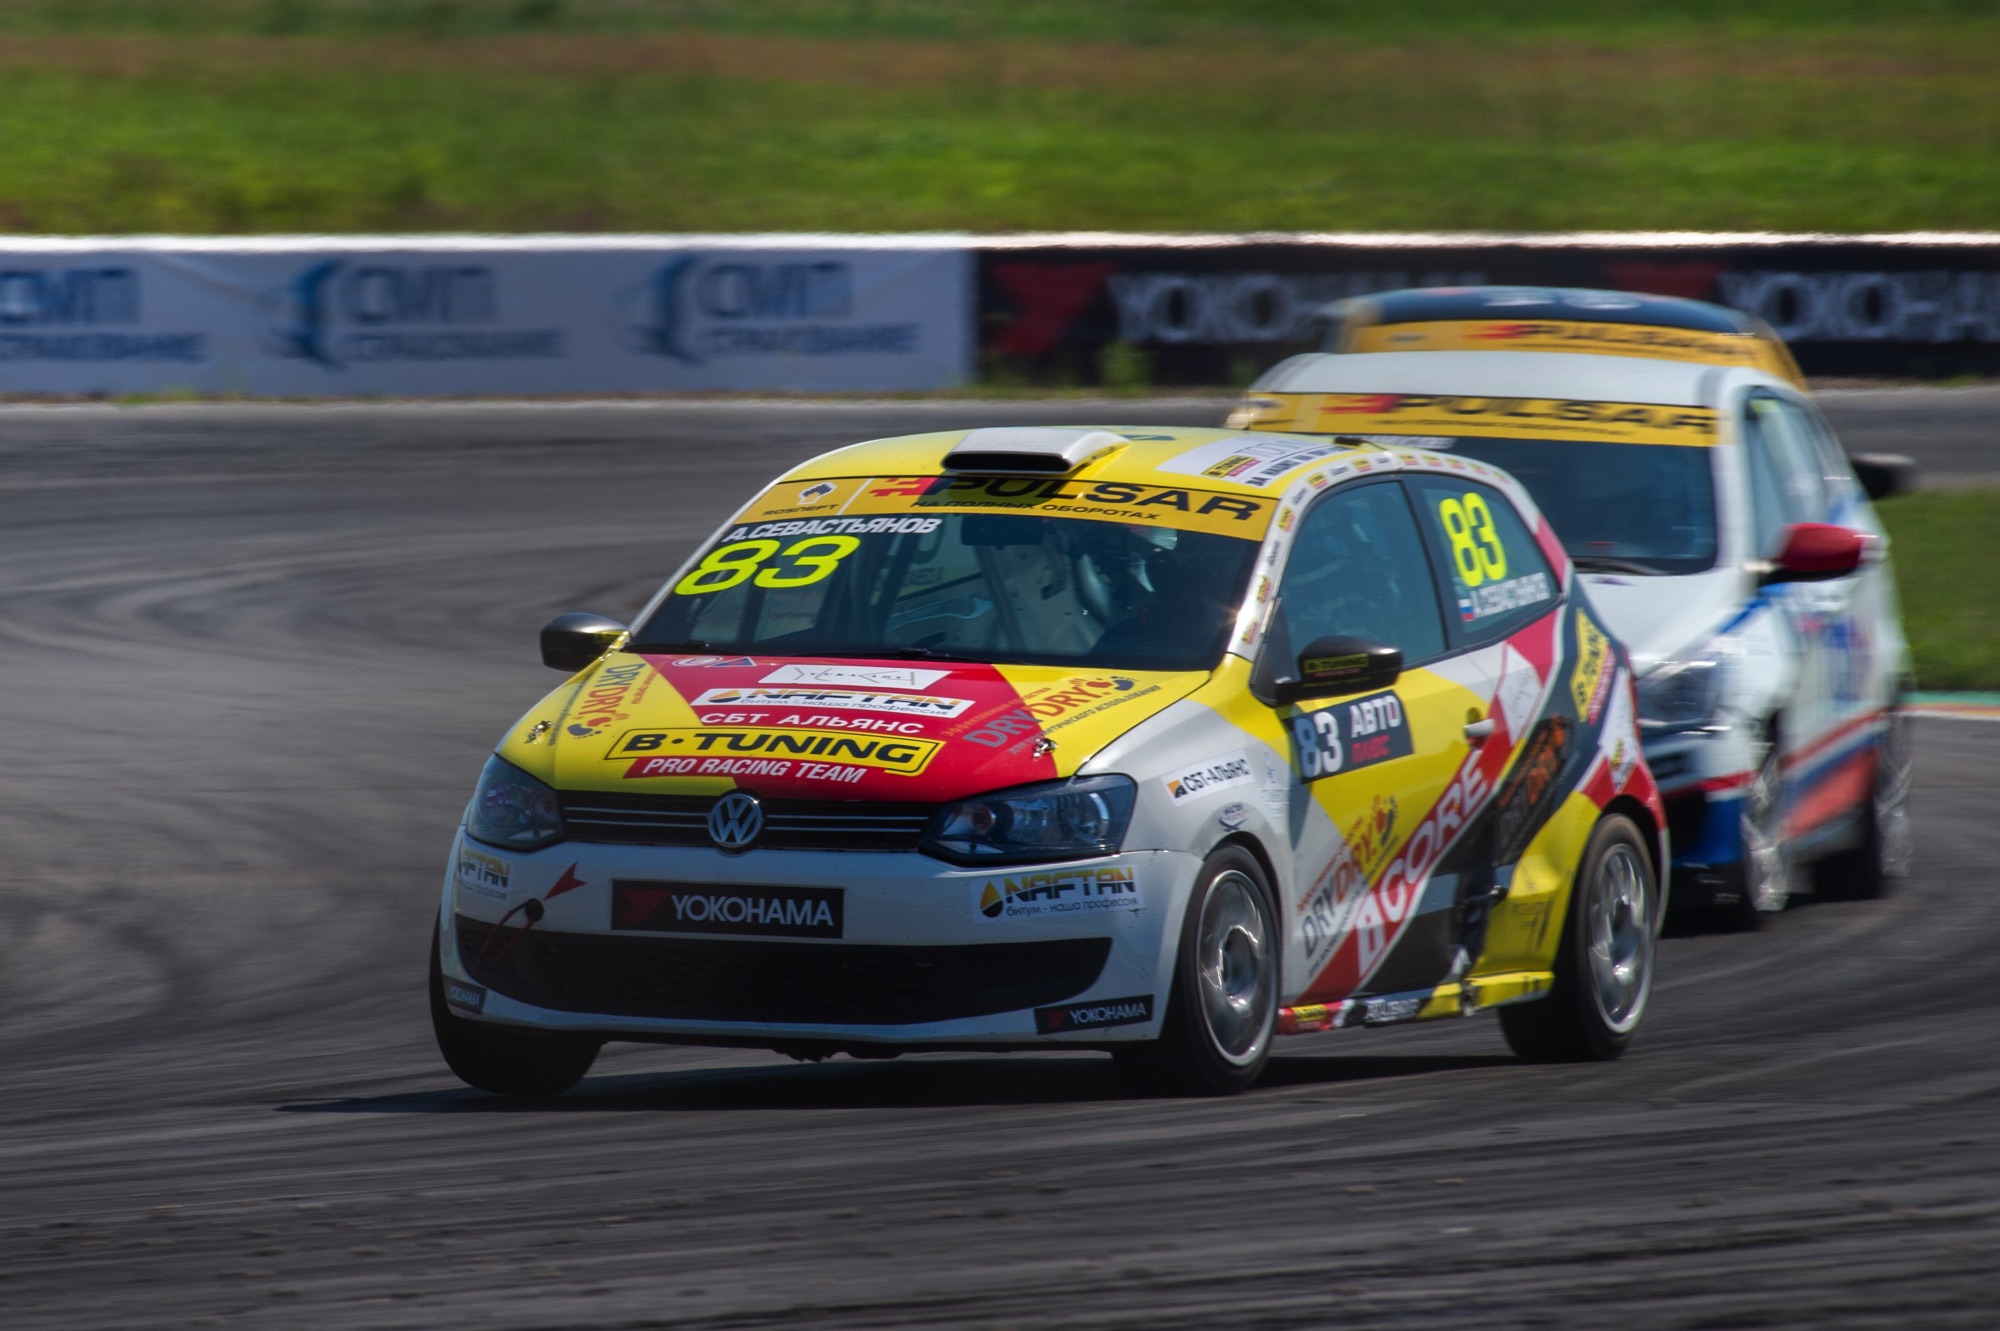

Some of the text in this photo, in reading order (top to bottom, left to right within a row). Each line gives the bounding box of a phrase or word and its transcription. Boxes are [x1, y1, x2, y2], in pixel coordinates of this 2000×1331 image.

[910, 500, 1160, 519] НА ПОЛНЫХ ОБОРОТАХ
[926, 477, 1261, 521] PULSAR
[1439, 492, 1508, 588] 83
[674, 535, 860, 595] 83
[746, 688, 962, 711] NAFTAN
[700, 713, 924, 734] СБТ АЛЬЯНС
[1349, 695, 1402, 738] АВТО
[1293, 711, 1343, 778] 83
[642, 758, 867, 784] PRO RACING TEAM
[1003, 866, 1136, 904] NAFTAN
[671, 893, 834, 926] YOKOHAMA
[1006, 902, 1042, 918] битум
[1050, 901, 1081, 913] наша
[1083, 897, 1138, 911] профессия
[1069, 1002, 1147, 1025] YOKOHAMA
